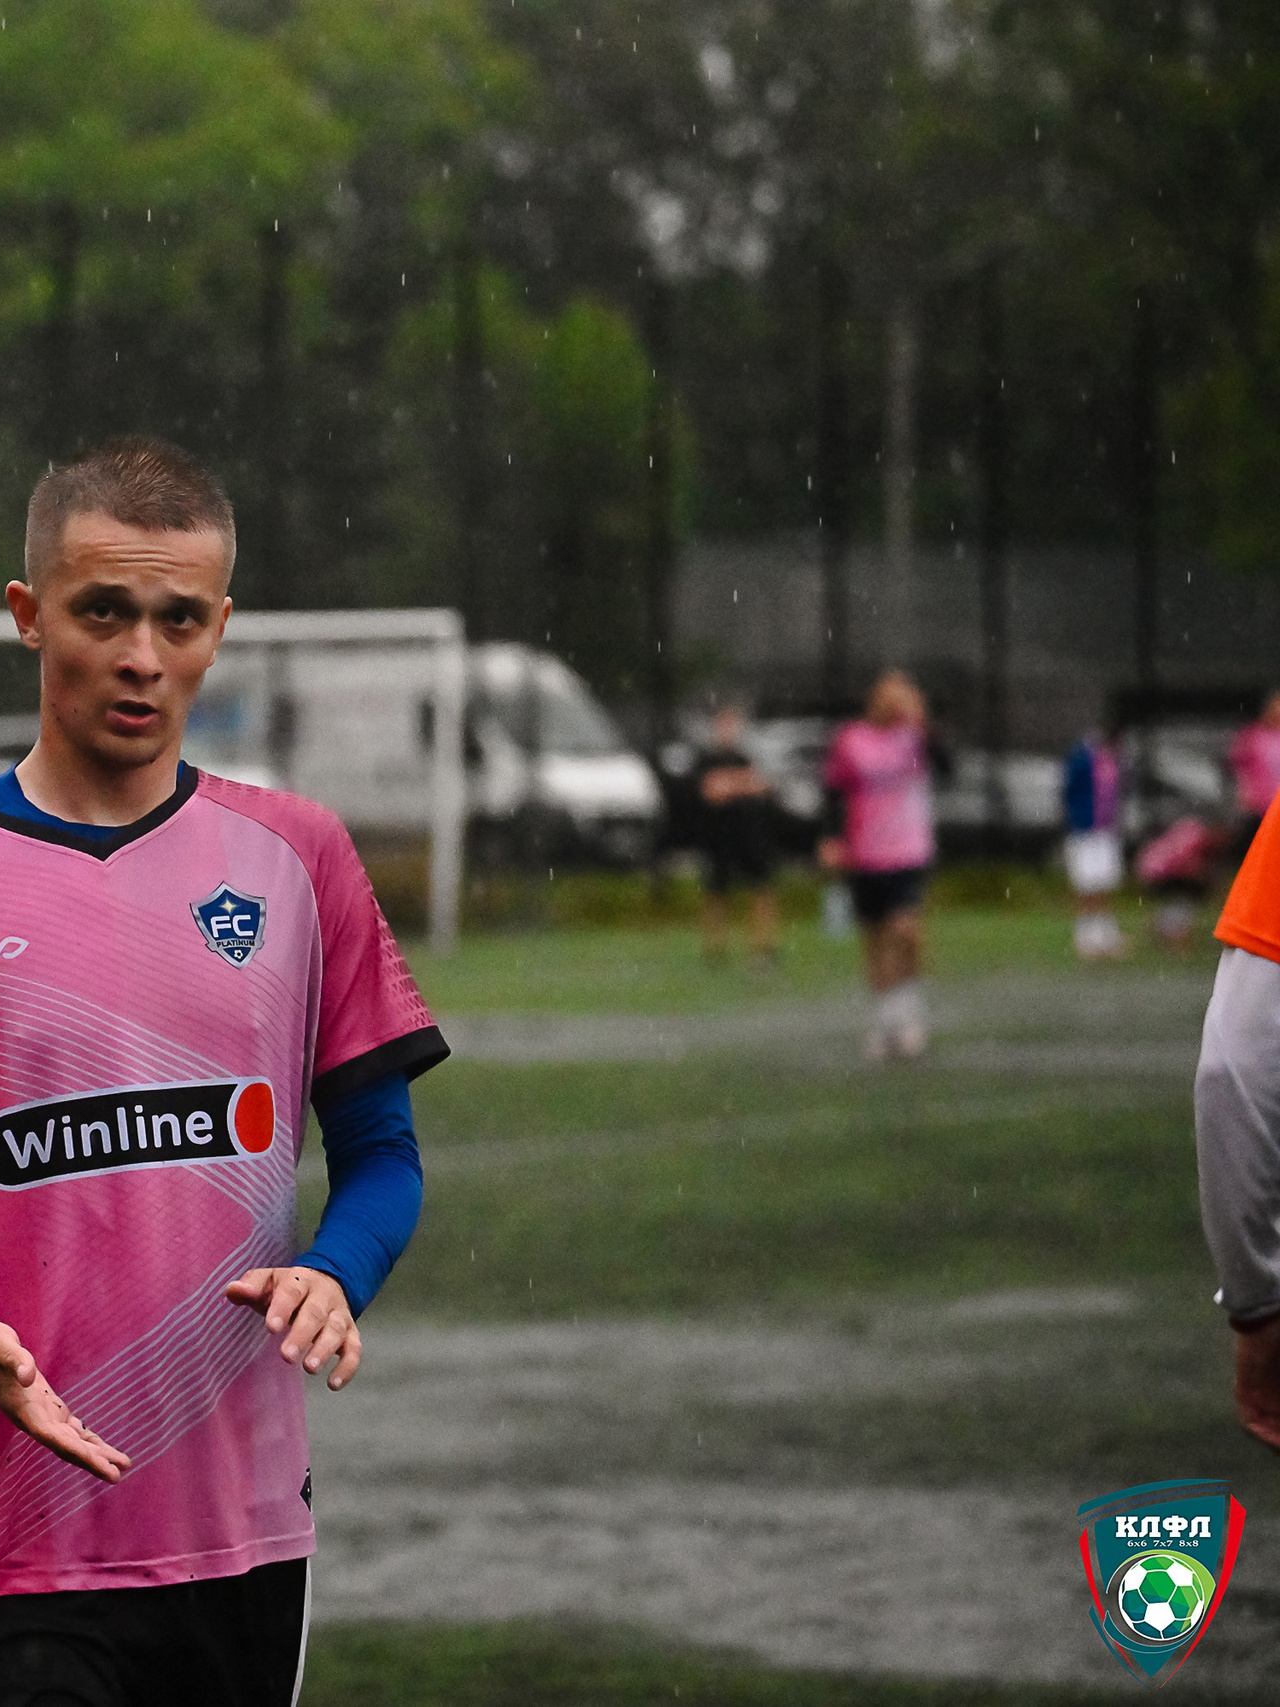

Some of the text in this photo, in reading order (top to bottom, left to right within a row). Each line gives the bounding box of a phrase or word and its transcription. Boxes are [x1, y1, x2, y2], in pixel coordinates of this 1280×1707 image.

[210, 914, 254, 938] FC
[216, 939, 256, 948] PLATINUM
[2, 1104, 214, 1170] Winline
